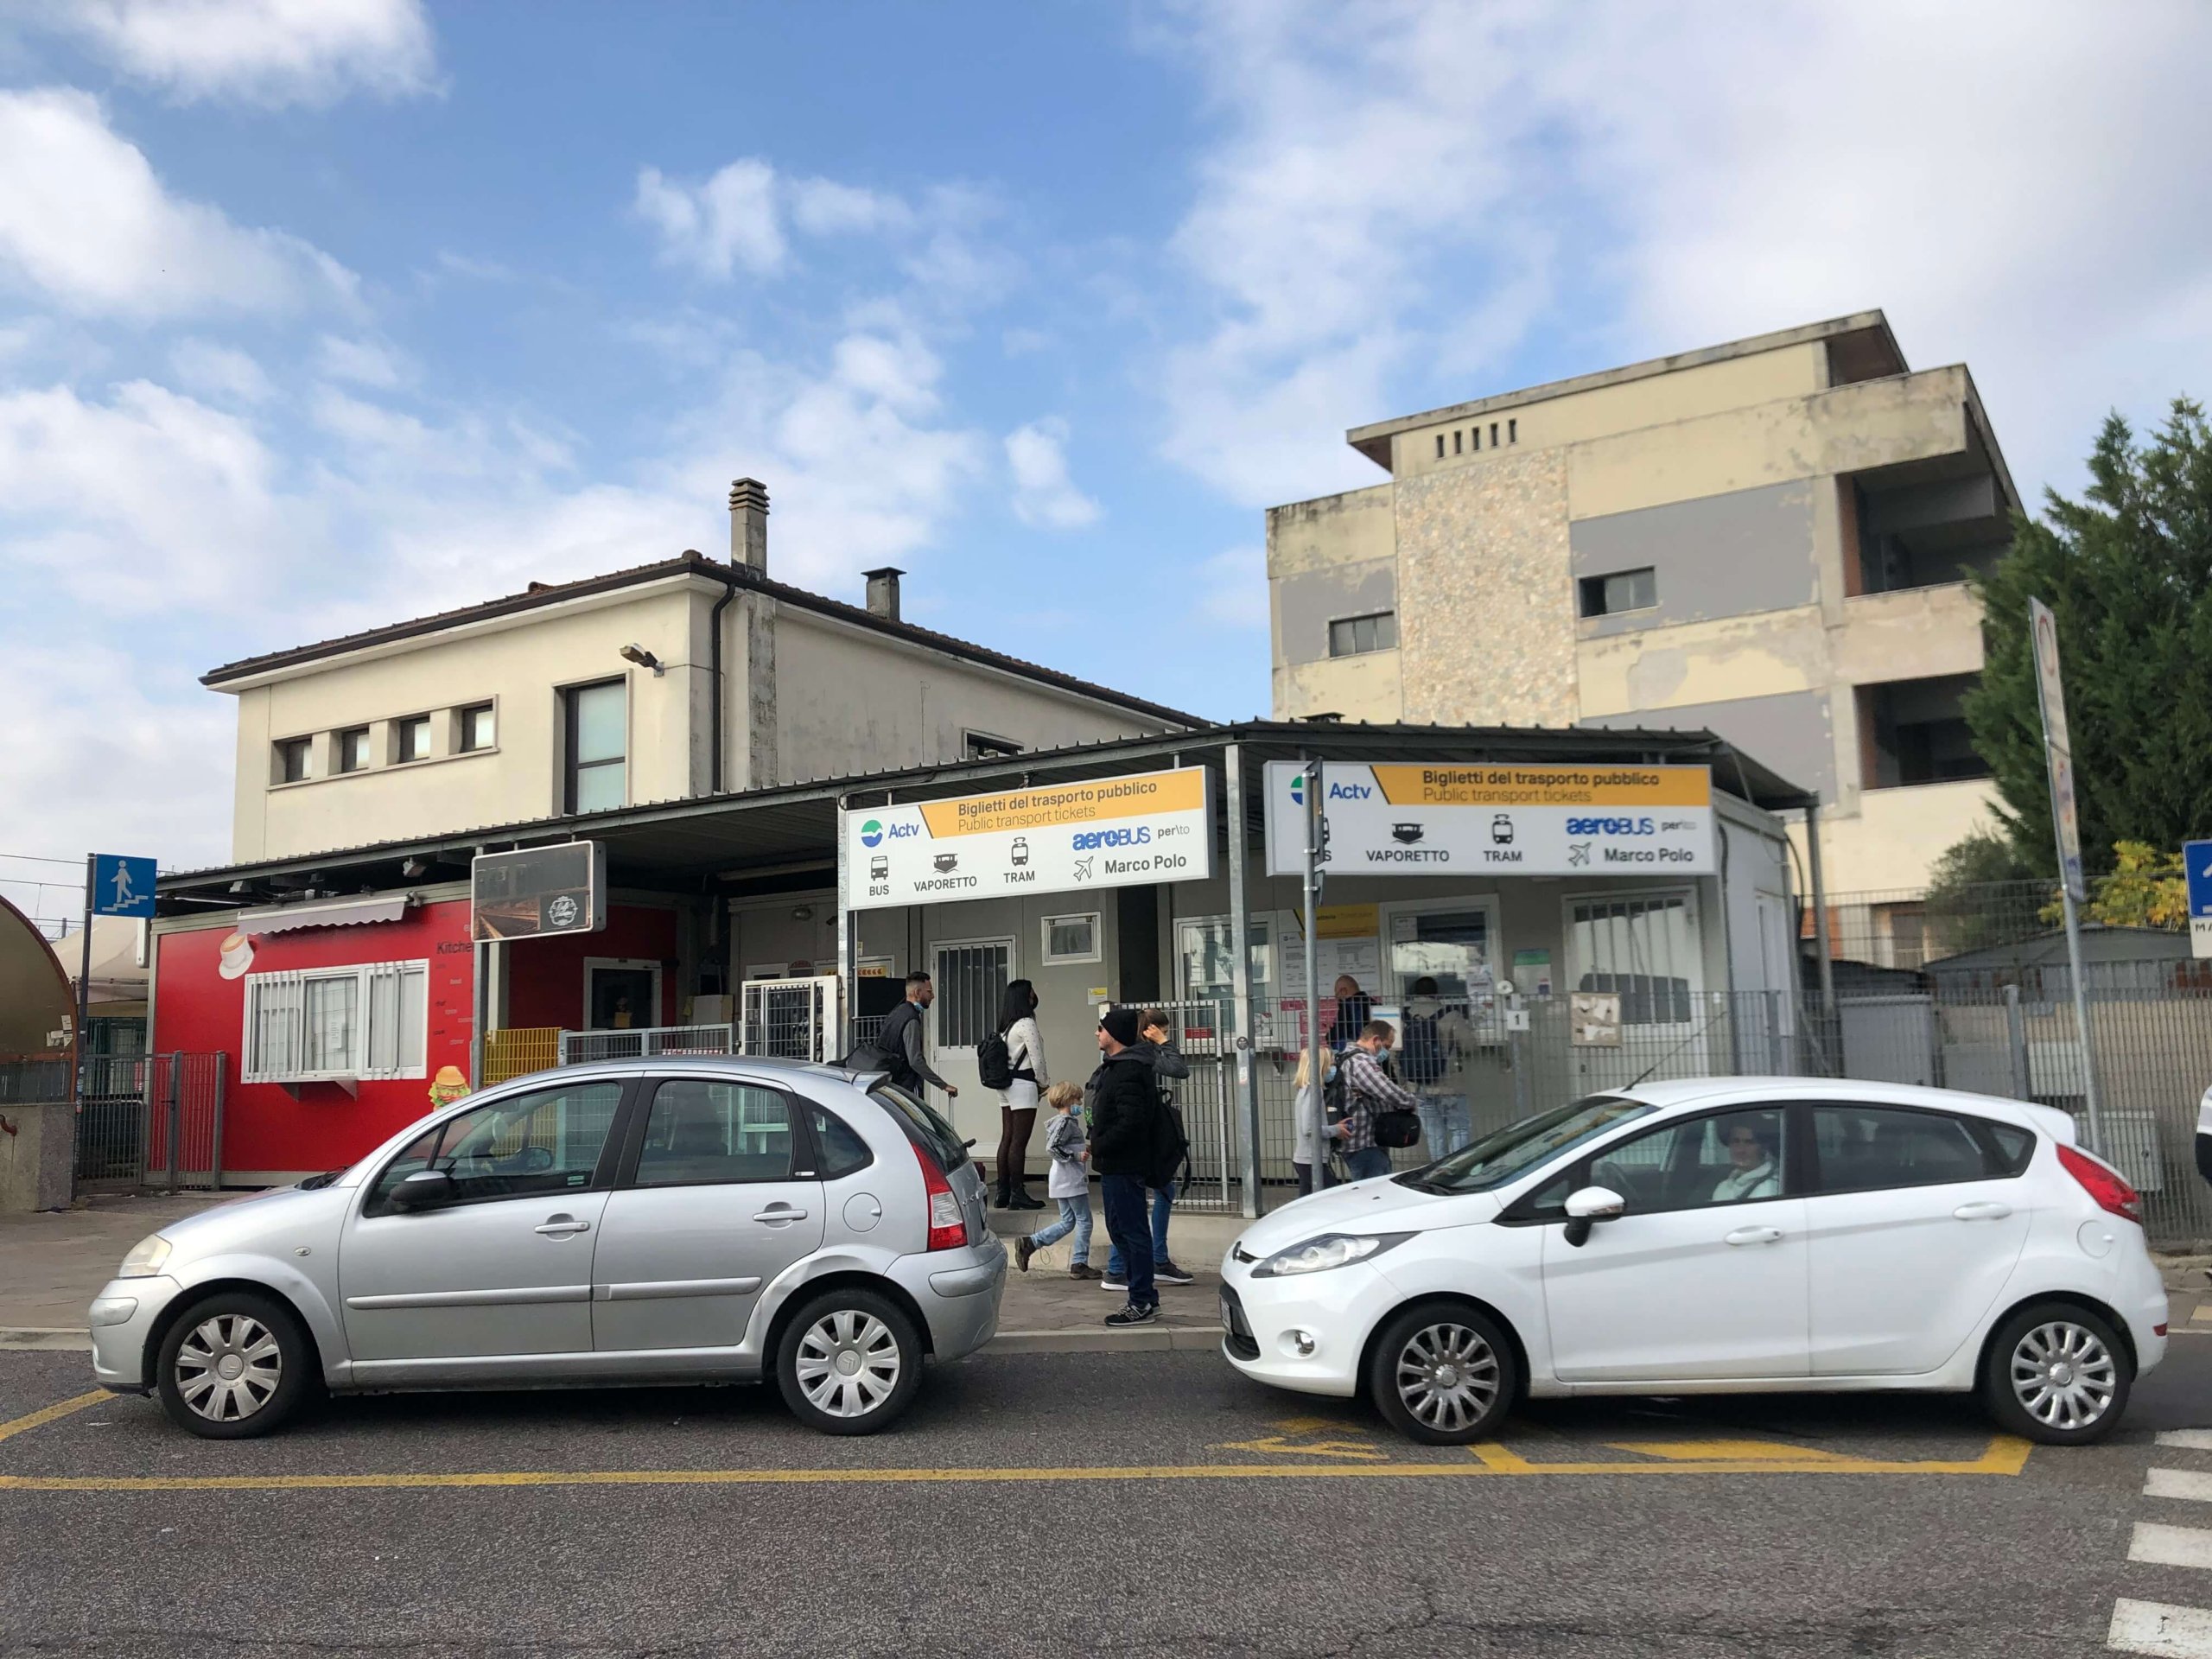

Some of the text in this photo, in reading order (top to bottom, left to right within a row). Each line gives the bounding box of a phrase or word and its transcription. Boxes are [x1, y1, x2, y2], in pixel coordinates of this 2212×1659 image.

[1423, 771, 1660, 788] Biglietti del trasporto pubblico
[1329, 782, 1371, 800] Actv
[1423, 787, 1592, 804] Public transport tickets
[958, 782, 1157, 817] Biglietti del trasporto pubblico
[958, 804, 1096, 832] Public transport tickets
[888, 823, 919, 839] Actv
[1566, 817, 1655, 836] aeroBUS
[1072, 826, 1151, 850] aeroBUS
[1366, 849, 1450, 862] VAPORETTO
[1484, 850, 1522, 862] TRAM
[1605, 848, 1694, 861] Marco Polo
[1105, 854, 1186, 874] Marco Polo
[914, 876, 977, 892] VAPORETTO
[1003, 871, 1035, 883] TRAM
[869, 884, 889, 896] BUS
[436, 941, 473, 955] Kitche
[1515, 1014, 1521, 1026] 1
